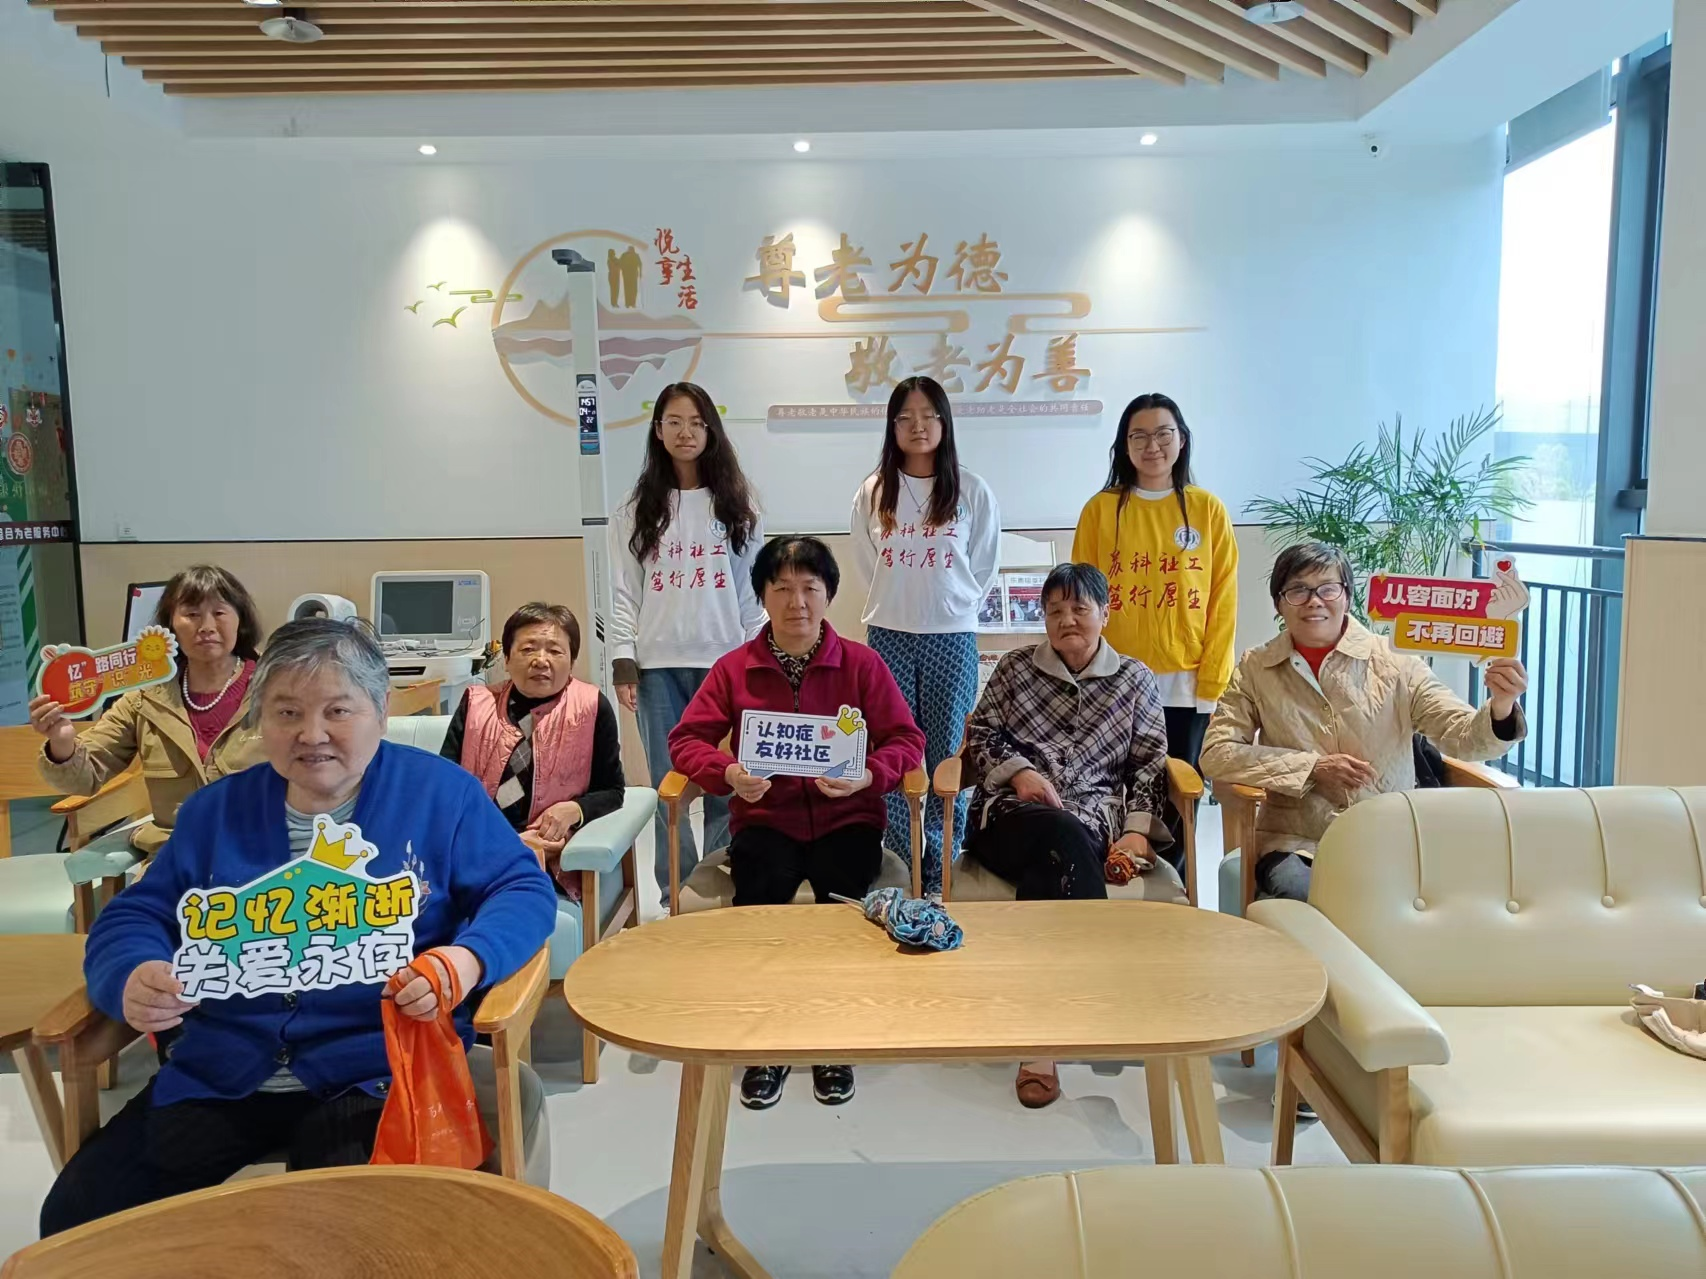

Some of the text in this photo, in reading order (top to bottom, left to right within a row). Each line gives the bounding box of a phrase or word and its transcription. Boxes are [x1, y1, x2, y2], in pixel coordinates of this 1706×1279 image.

[676, 254, 698, 309] 生活
[745, 232, 1008, 302] 尊老为德
[845, 332, 1091, 394] 敬老为善
[881, 547, 954, 568] 笃行厚生
[1107, 551, 1203, 579] 苏科社工
[651, 567, 727, 592] 笃行厚生
[1107, 581, 1201, 611] 笃行厚生
[1382, 583, 1480, 611] 从容面对
[1406, 619, 1504, 649] 不再回避
[757, 721, 815, 742] 认知症
[755, 740, 831, 762] 友好社区
[182, 876, 413, 940] 记忆渐逝
[176, 929, 408, 998] 关爱永存
